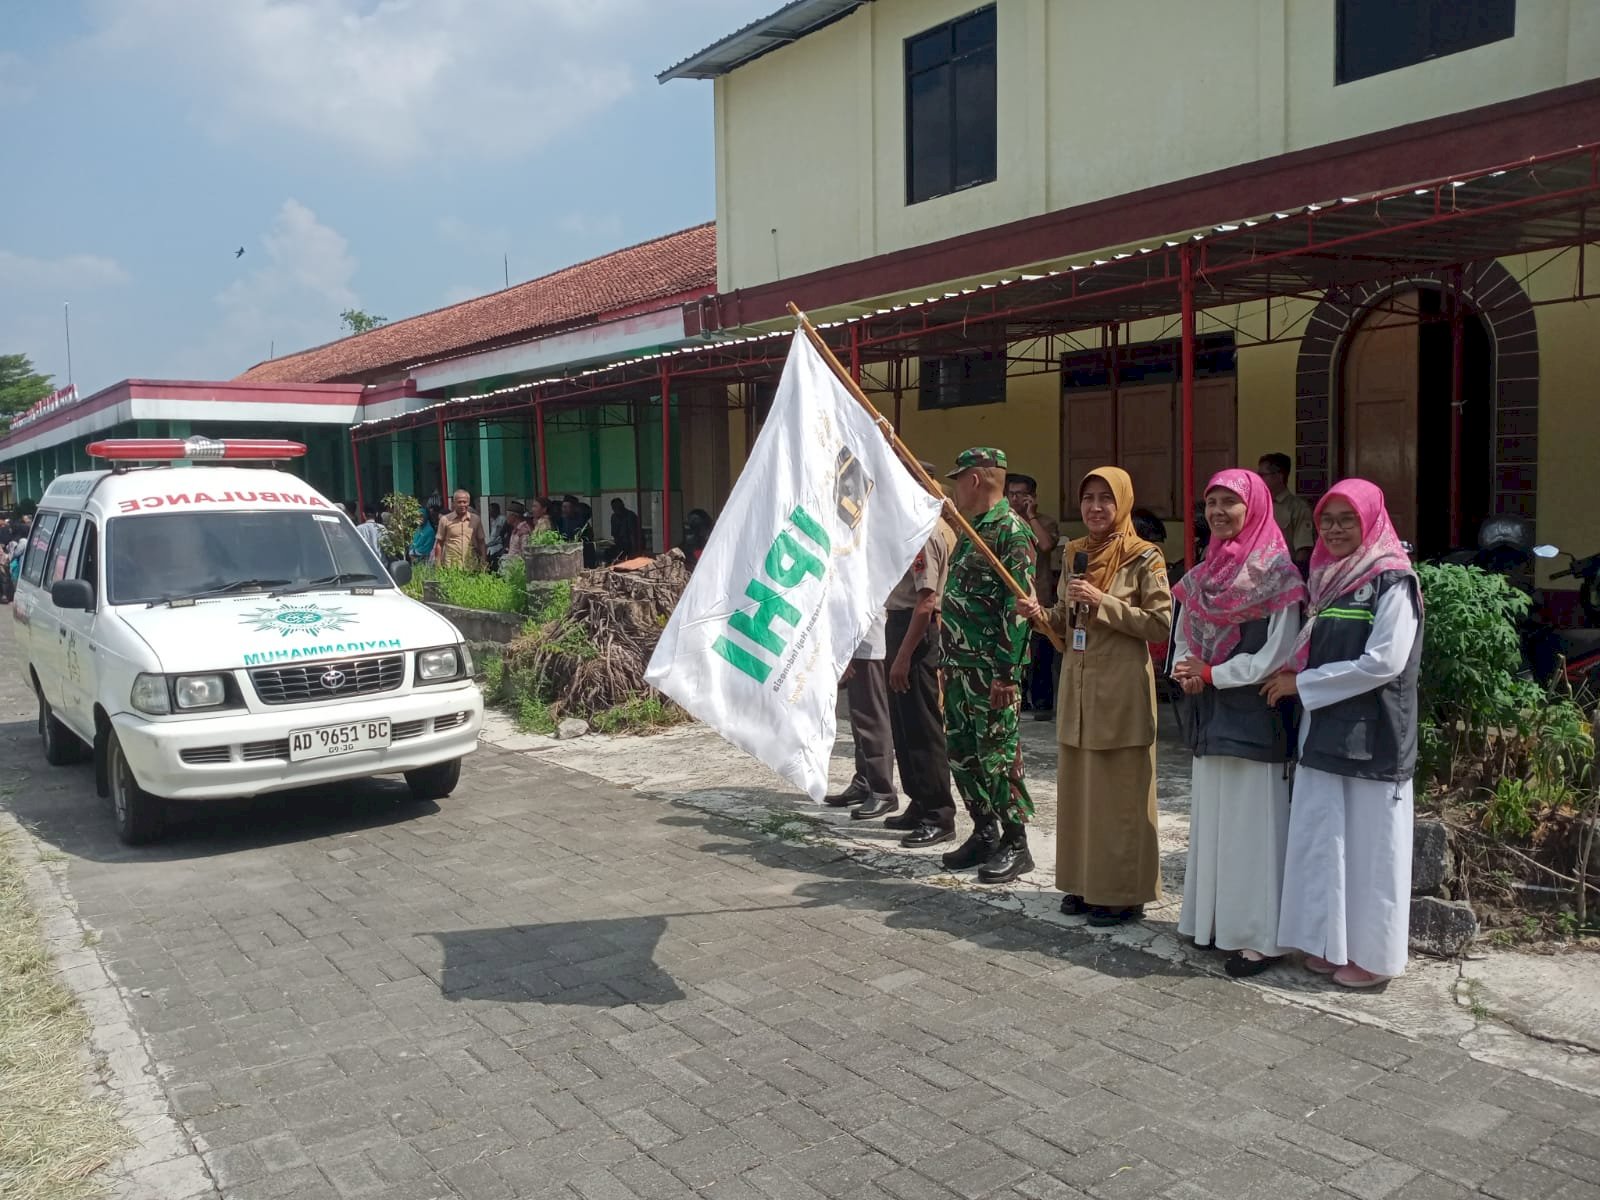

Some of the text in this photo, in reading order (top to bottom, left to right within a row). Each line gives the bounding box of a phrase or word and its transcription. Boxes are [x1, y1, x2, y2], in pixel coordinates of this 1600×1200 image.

[243, 639, 402, 666] MUHAMMADIYAH
[293, 722, 388, 752] AD 9651 BC
